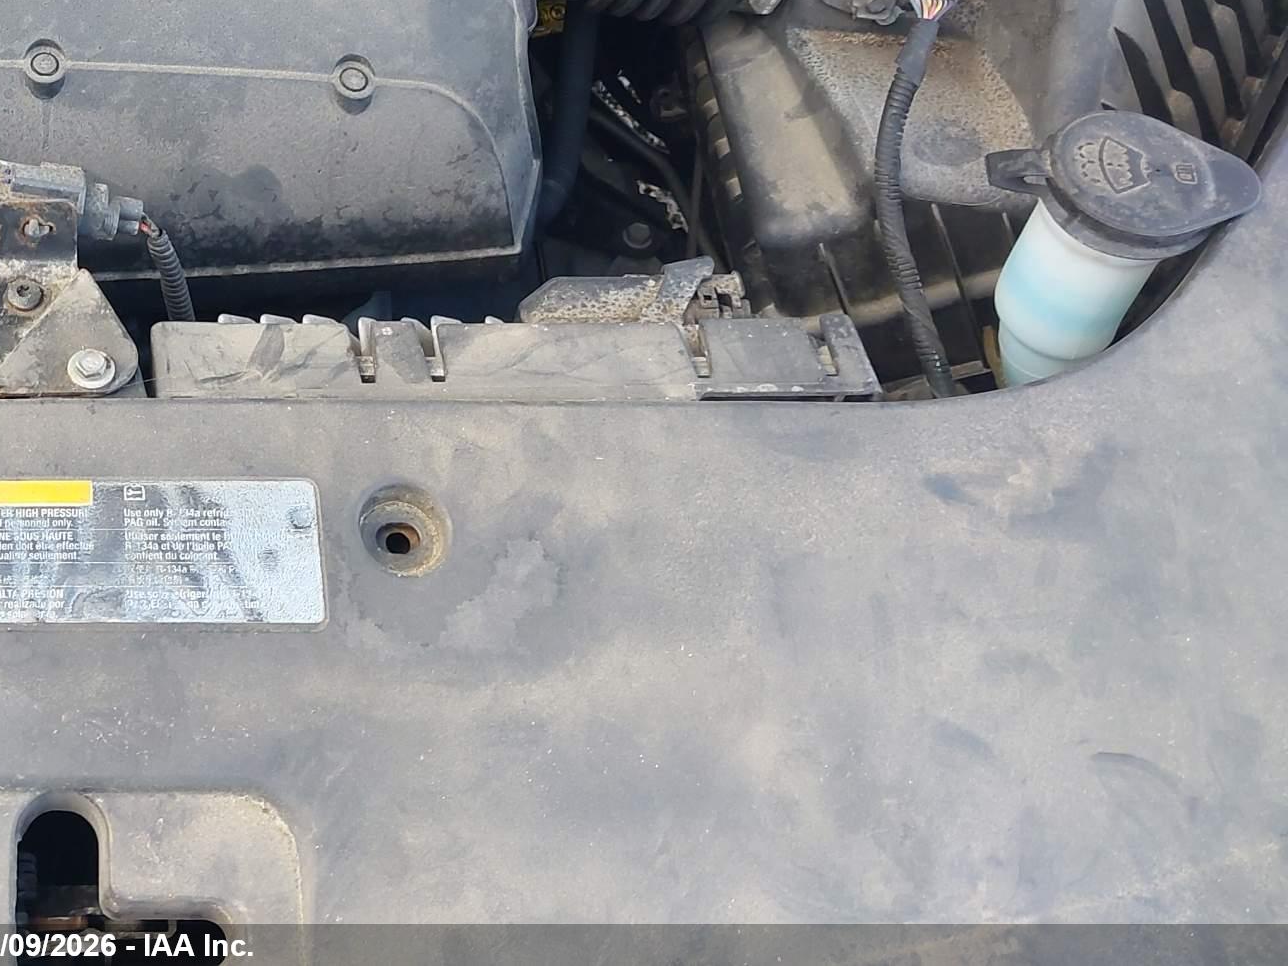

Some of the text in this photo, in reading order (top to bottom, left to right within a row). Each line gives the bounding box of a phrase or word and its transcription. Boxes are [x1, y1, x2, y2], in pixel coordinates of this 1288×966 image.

[15, 507, 39, 518] HIGH
[123, 508, 142, 517] Use
[144, 508, 163, 519] only
[52, 519, 73, 529] only.
[124, 518, 143, 527] PAG
[145, 518, 161, 527] oil.
[163, 518, 197, 528] Syem
